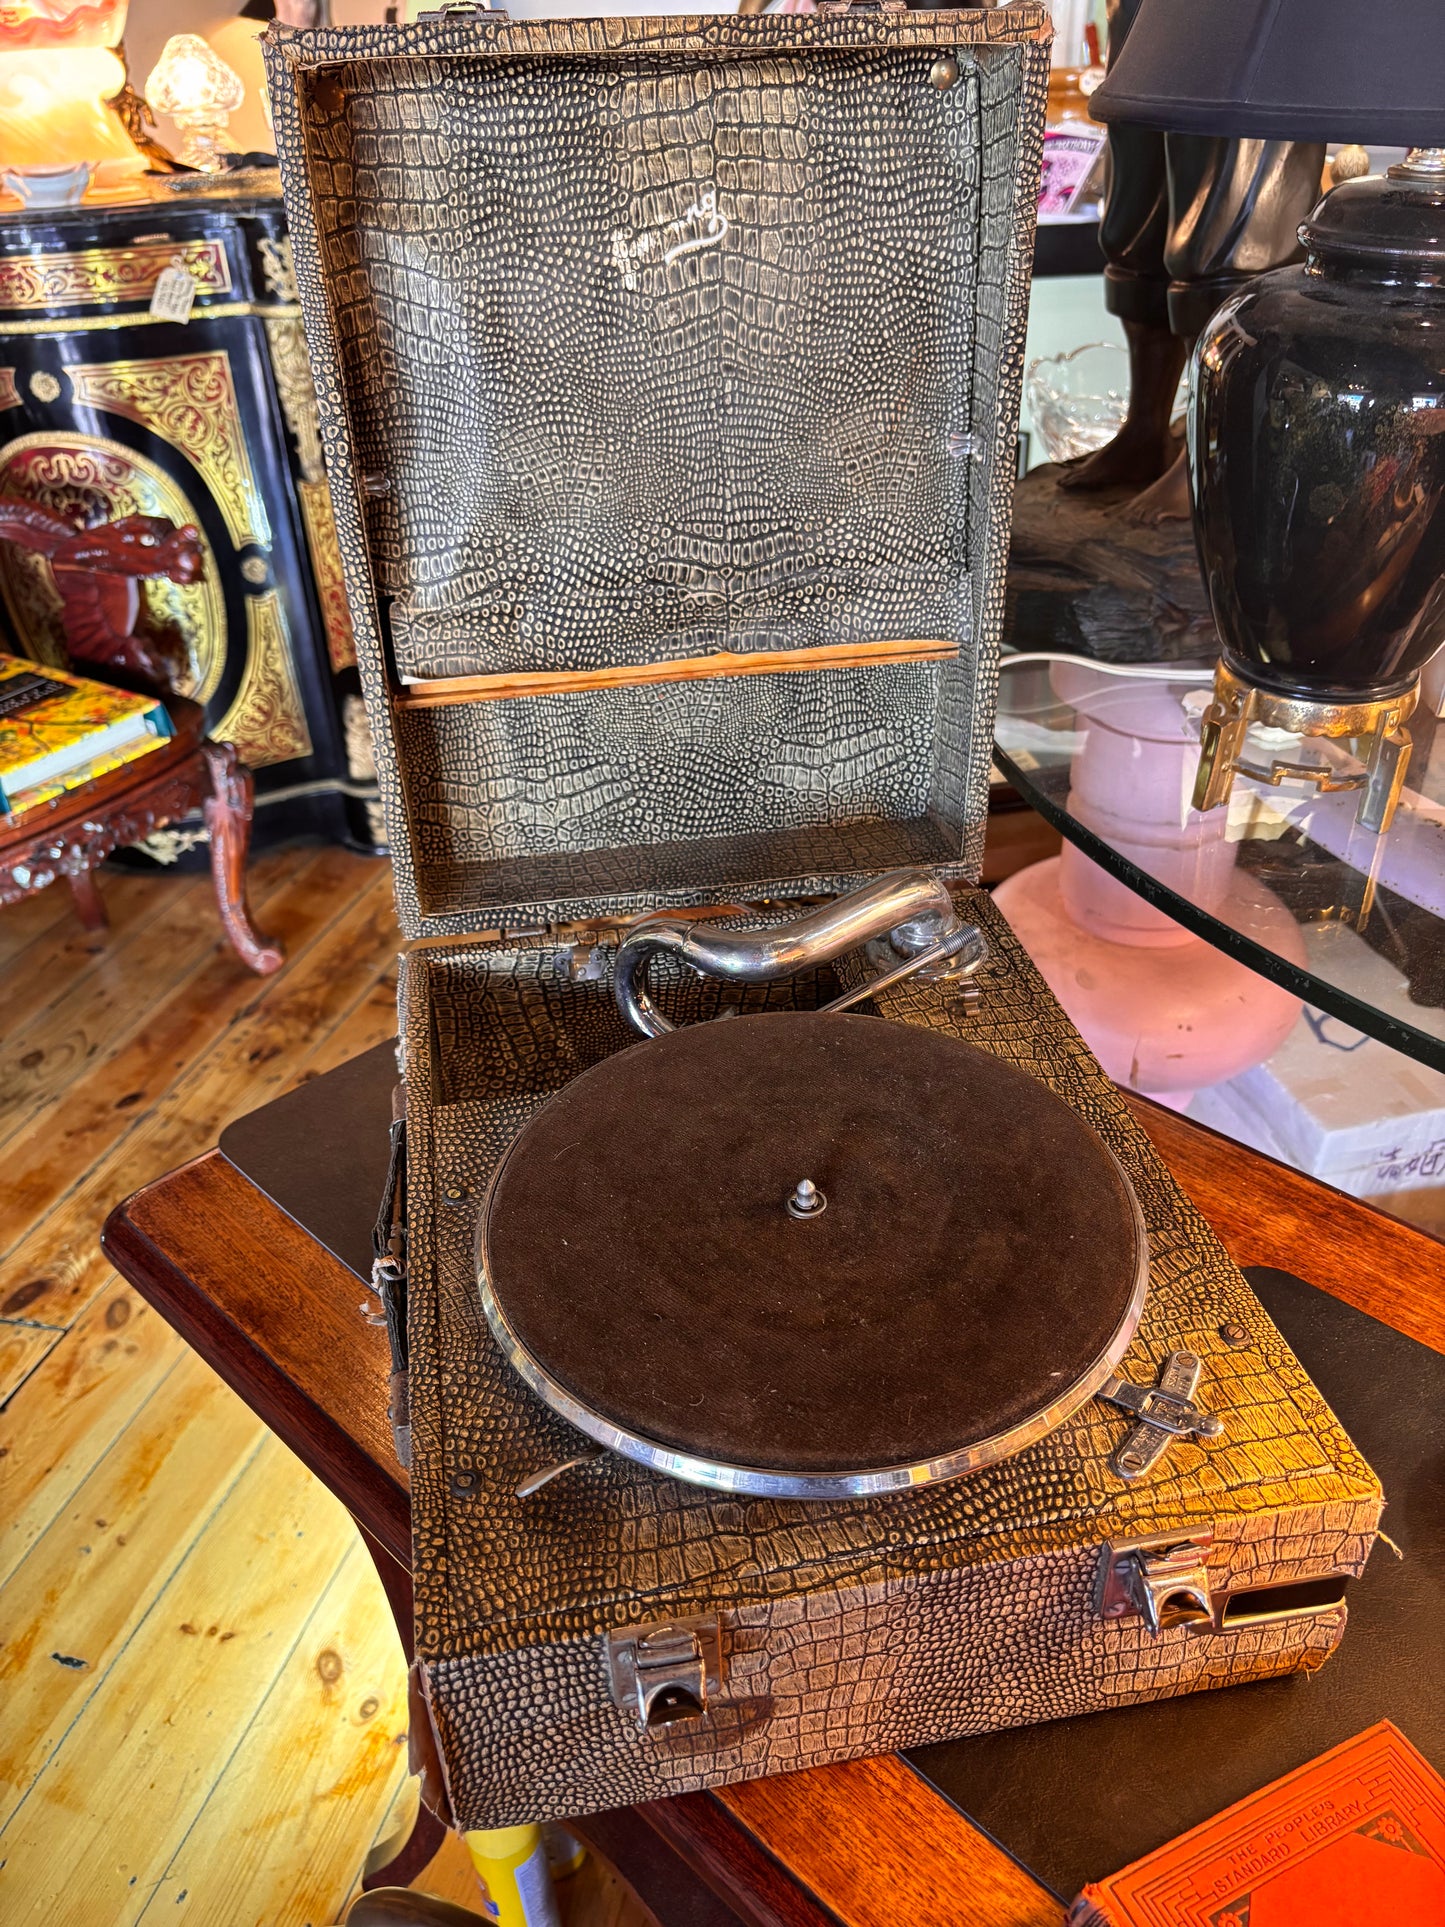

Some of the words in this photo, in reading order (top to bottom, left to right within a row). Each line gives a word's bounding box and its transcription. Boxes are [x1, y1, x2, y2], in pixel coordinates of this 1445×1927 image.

[1213, 1842, 1291, 1894] STANDARD
[1299, 1799, 1361, 1843] LIBRARY
[1226, 1843, 1258, 1865] THE
[1264, 1800, 1335, 1845] PEOPLE'S
